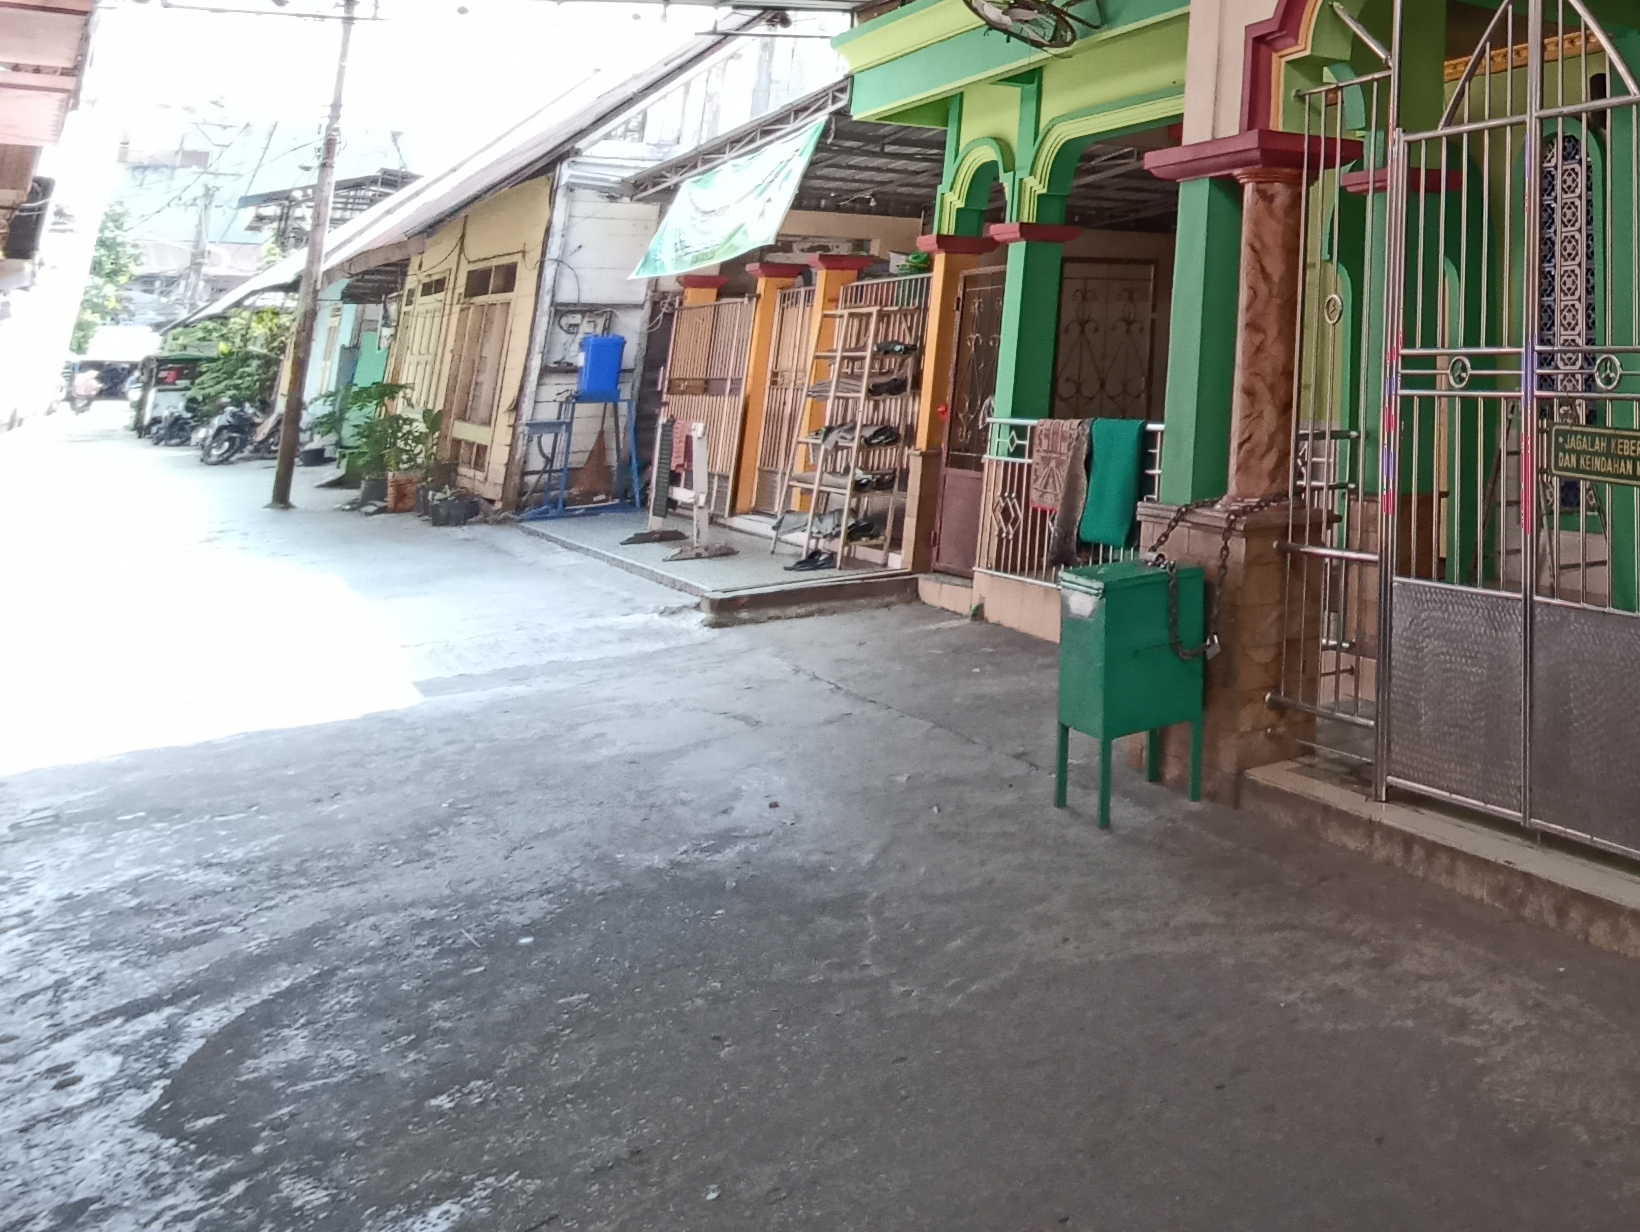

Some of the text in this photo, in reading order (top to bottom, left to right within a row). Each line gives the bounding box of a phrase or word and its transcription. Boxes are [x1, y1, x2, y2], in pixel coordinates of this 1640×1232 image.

[1564, 434, 1607, 453] JAGALAH
[1558, 451, 1577, 469] DAN
[1579, 454, 1633, 475] KEINDAHAN
